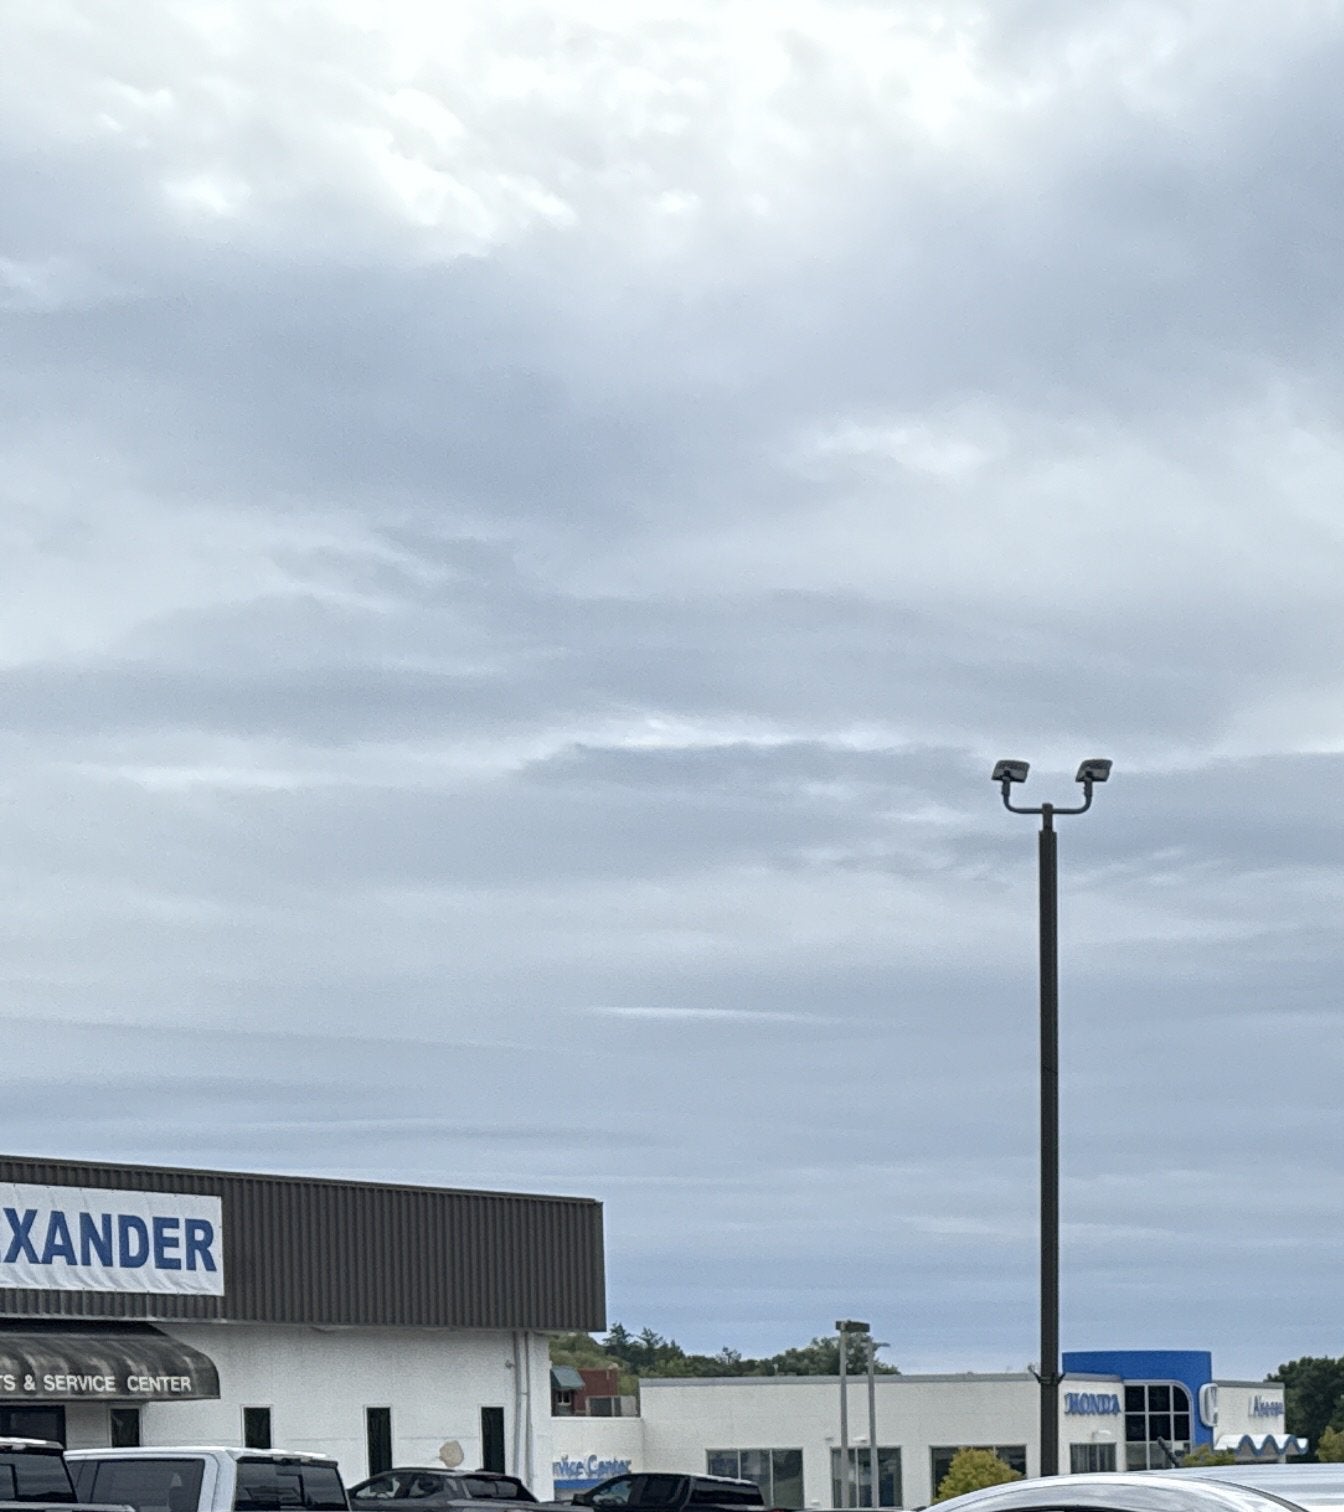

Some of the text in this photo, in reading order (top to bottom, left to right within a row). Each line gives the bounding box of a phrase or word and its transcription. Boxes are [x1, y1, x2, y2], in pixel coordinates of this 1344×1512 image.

[2, 1207, 218, 1272] XANDER
[0, 1374, 192, 1392] S & SERVICE CENTER
[1064, 1392, 1121, 1416] HONDA
